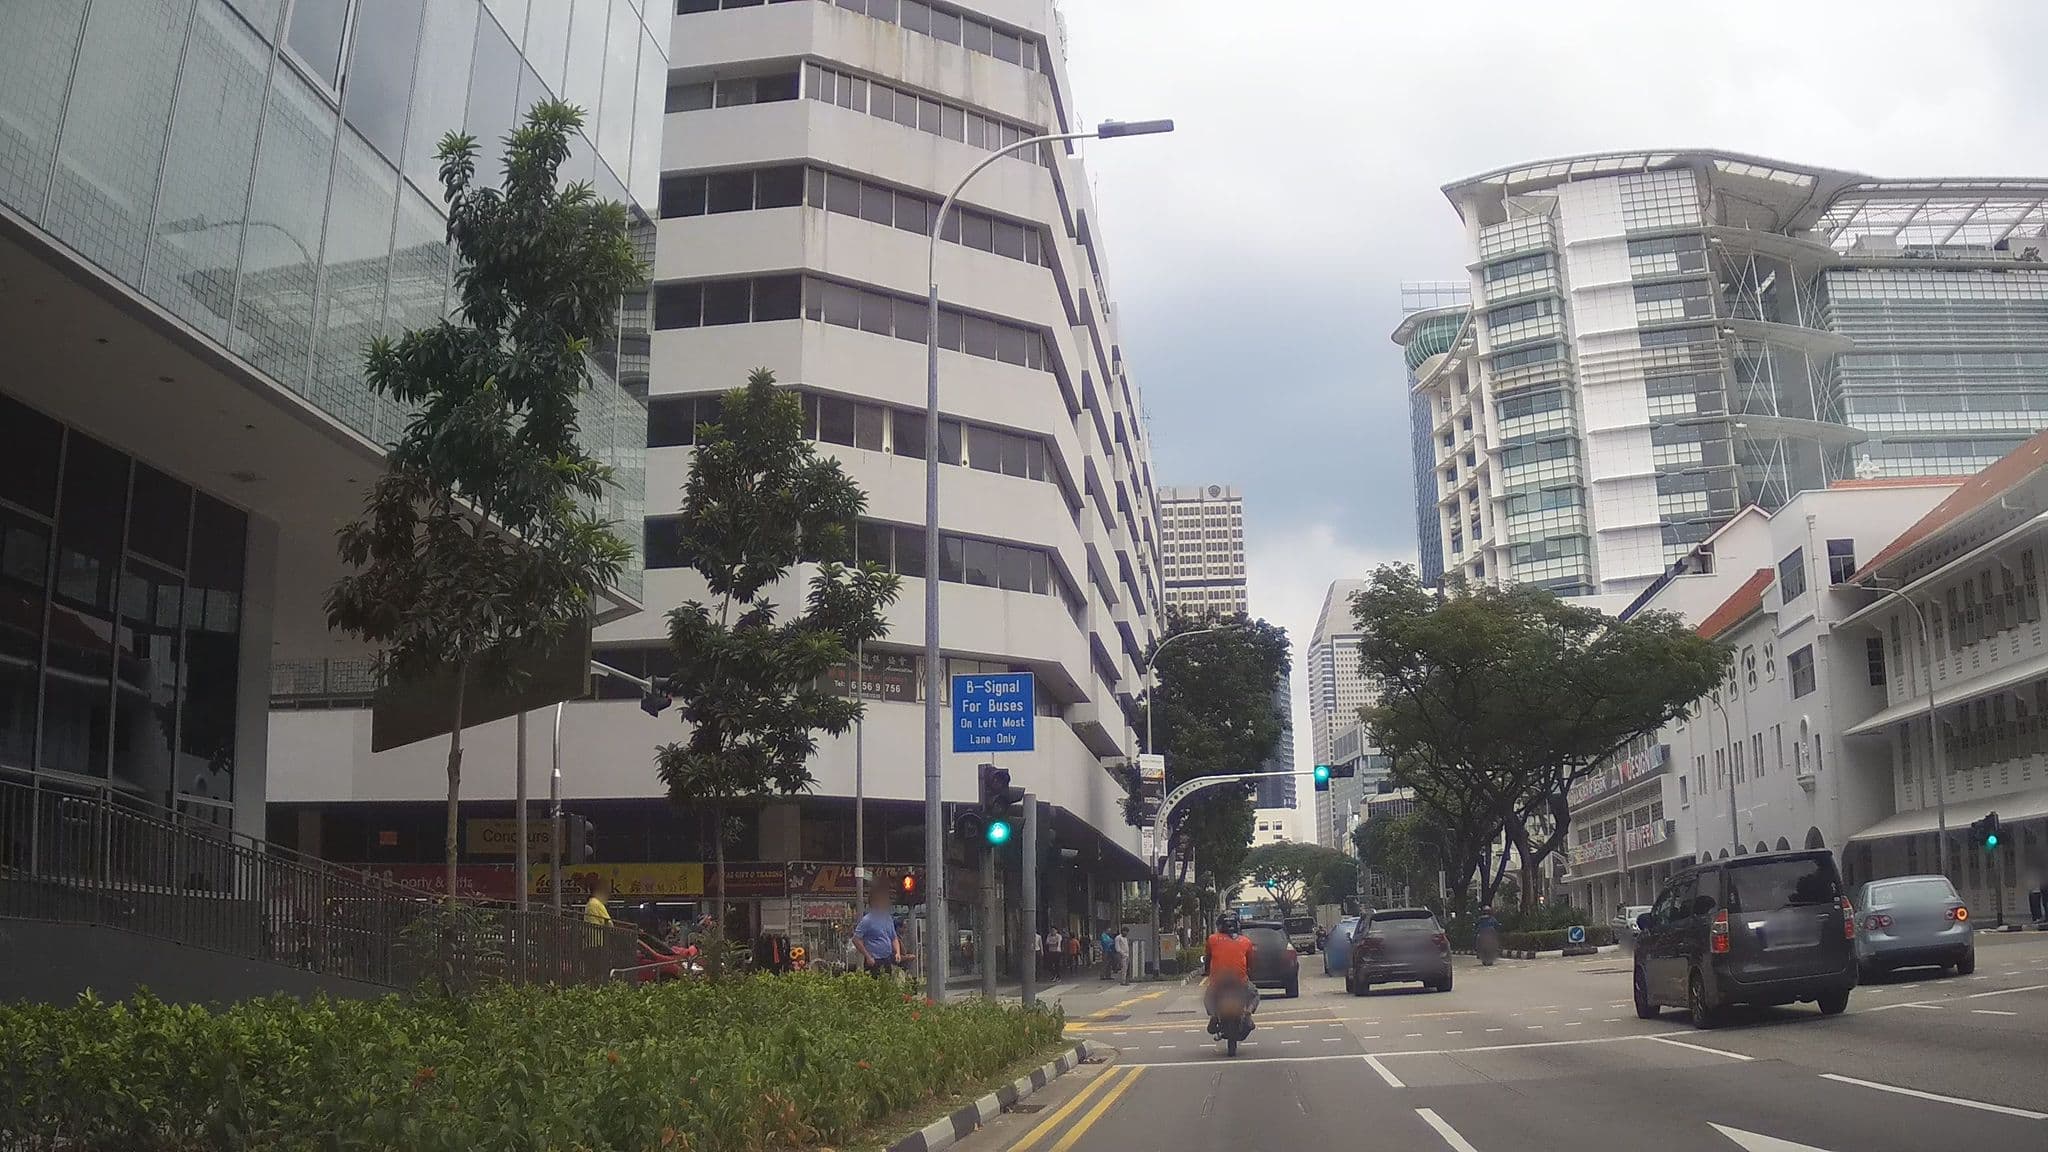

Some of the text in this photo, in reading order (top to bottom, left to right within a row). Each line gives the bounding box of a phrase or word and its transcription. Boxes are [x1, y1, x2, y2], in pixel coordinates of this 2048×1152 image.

[966, 679, 1020, 697] B-Signal
[962, 698, 1024, 713] For Buses
[960, 717, 1026, 729] On Left Most
[970, 732, 1017, 746] Lane Only
